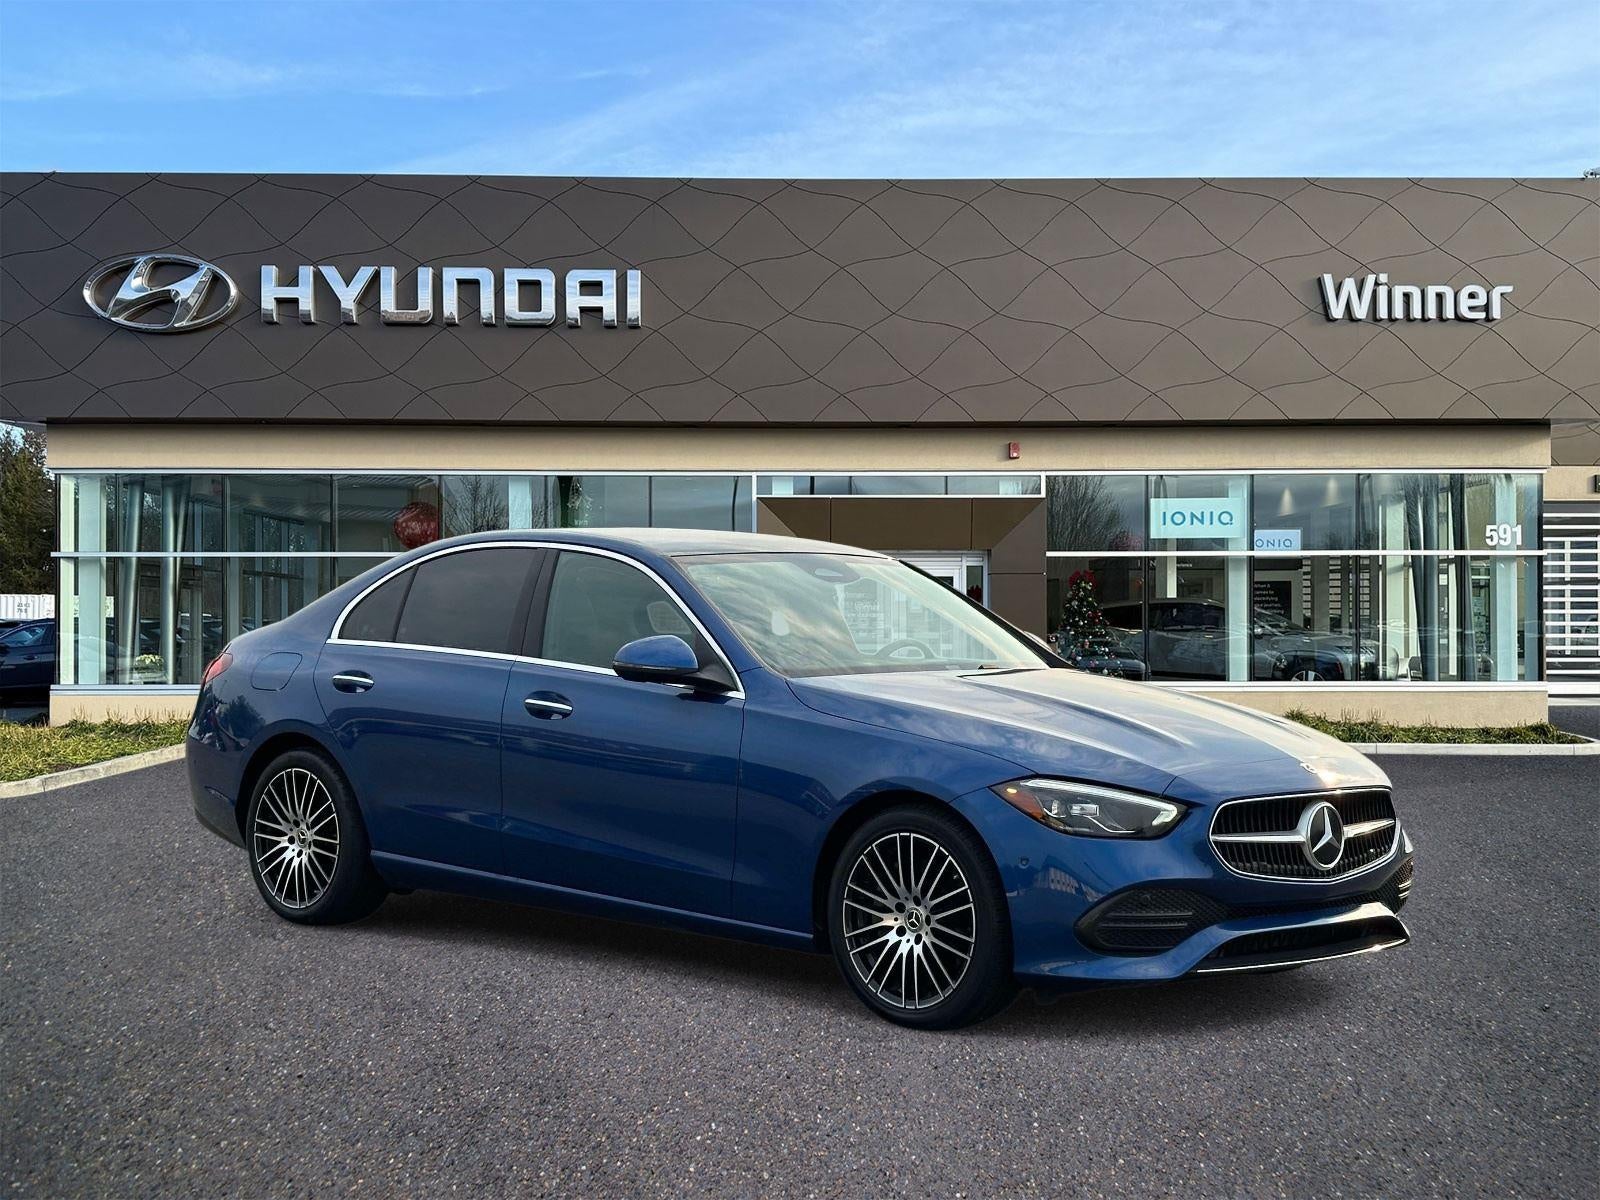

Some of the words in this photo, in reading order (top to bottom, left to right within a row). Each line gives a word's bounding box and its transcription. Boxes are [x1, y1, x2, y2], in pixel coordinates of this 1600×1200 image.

[260, 264, 642, 328] HYUNDAI
[1319, 272, 1514, 321] Winner
[1161, 510, 1234, 526] IONIQ
[1254, 538, 1293, 548] ONIQ
[1485, 523, 1523, 546] 591
